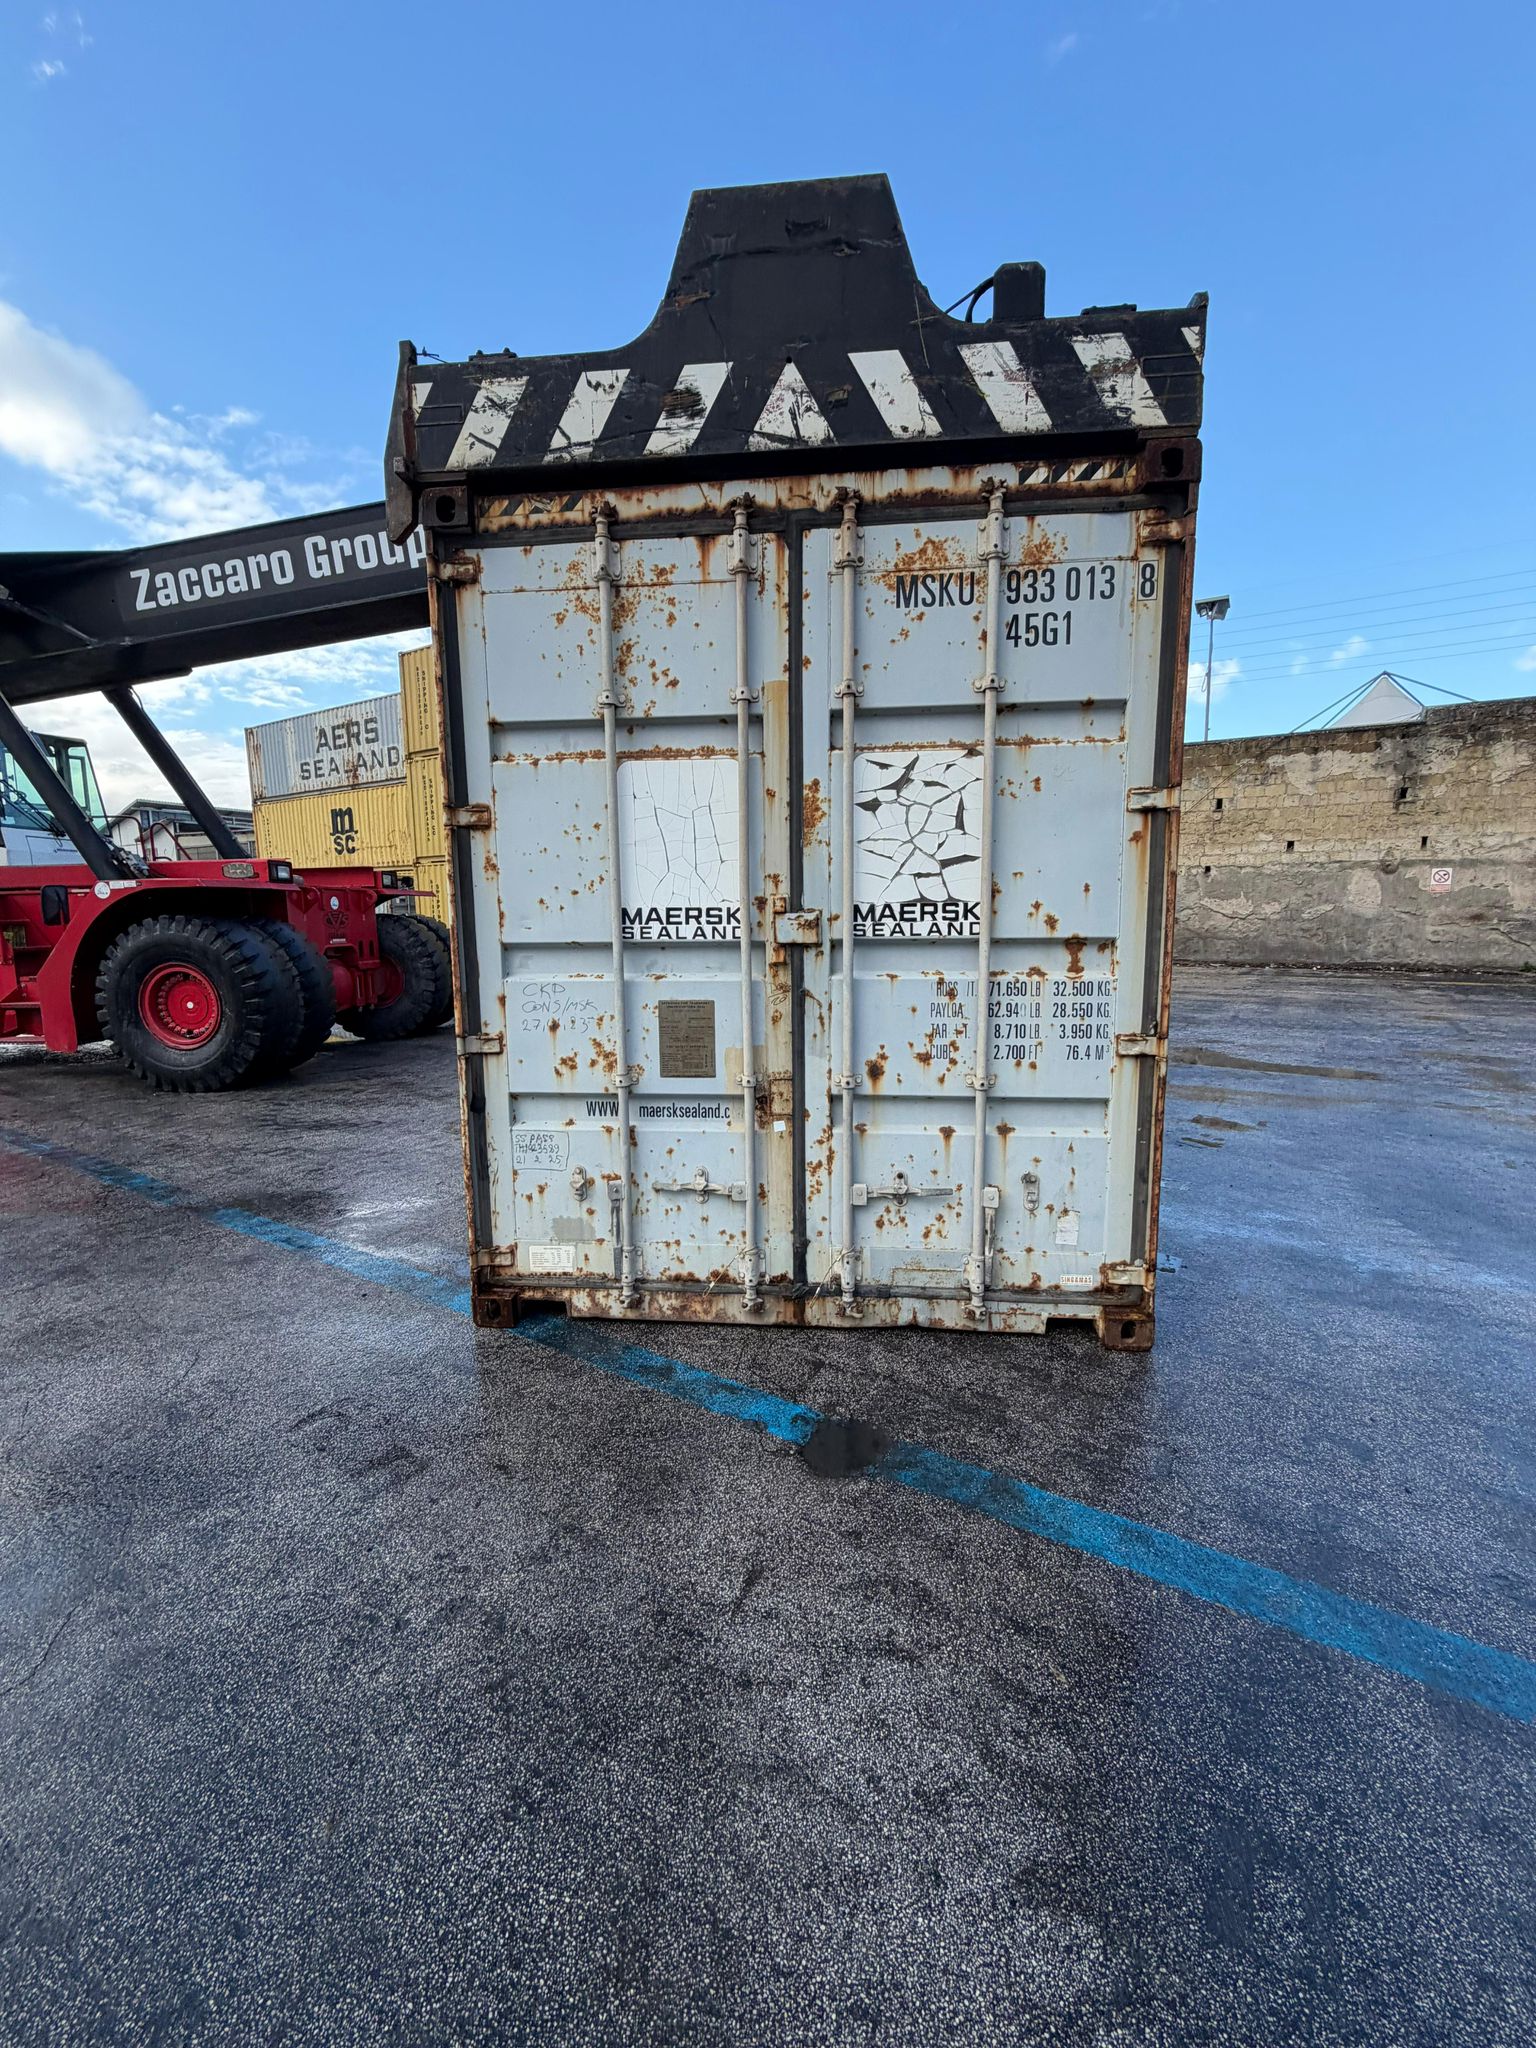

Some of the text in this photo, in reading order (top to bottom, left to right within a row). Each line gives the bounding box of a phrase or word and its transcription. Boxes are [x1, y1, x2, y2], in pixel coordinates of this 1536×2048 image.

[130, 524, 427, 611] Zaccaro Group
[896, 563, 1156, 608] MSKU 933 013 8
[1006, 610, 1072, 647] 45G1
[316, 717, 379, 753] AERS
[300, 746, 400, 780] SEALAND
[621, 907, 741, 925] MAERSK
[853, 902, 981, 922] MAERSK
[622, 926, 741, 939] SEALAND
[853, 922, 981, 937] SEALAND
[931, 981, 958, 997] ROSS
[931, 1002, 964, 1018] PAYLOA
[931, 1023, 947, 1039] TAR
